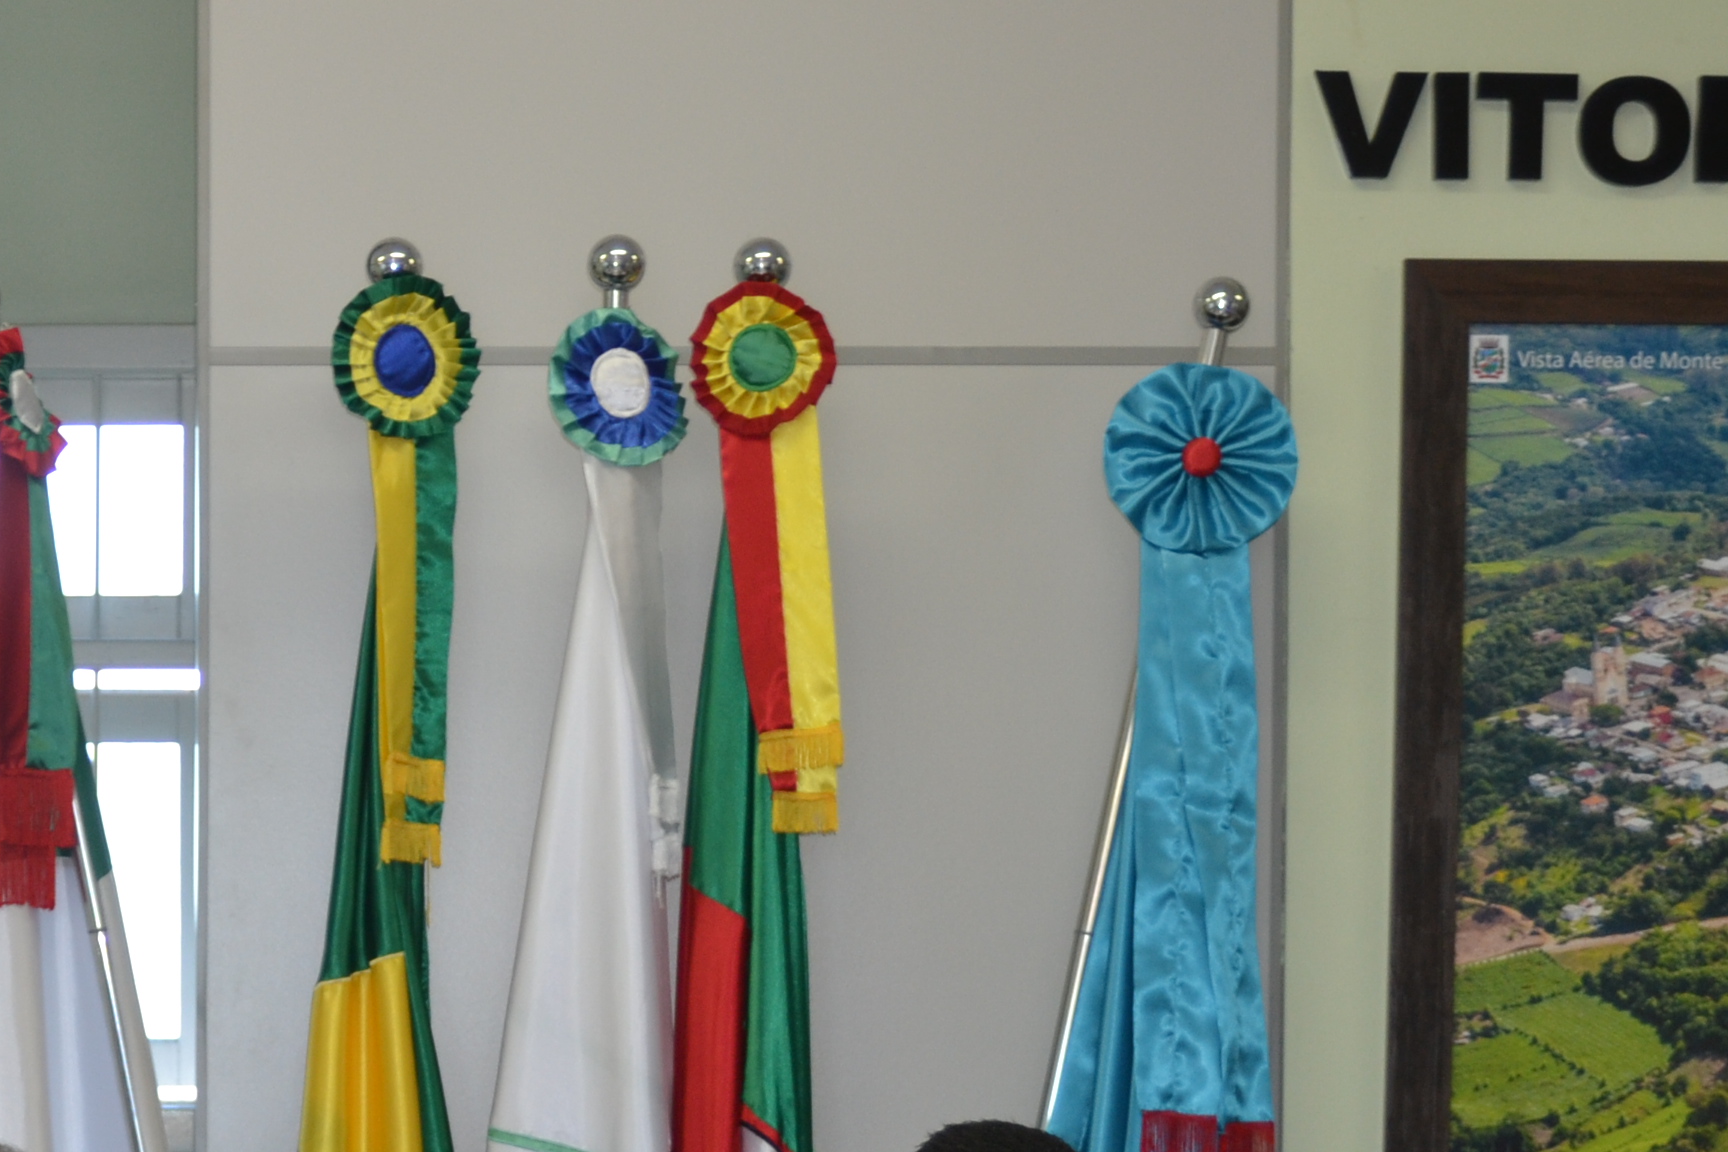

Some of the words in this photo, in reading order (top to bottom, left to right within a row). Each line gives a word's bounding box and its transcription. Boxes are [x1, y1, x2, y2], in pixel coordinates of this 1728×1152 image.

[1517, 350, 1564, 369] Vista
[1568, 350, 1626, 370] Aérea
[1629, 351, 1655, 370] de
[1659, 351, 1723, 371] Monte
